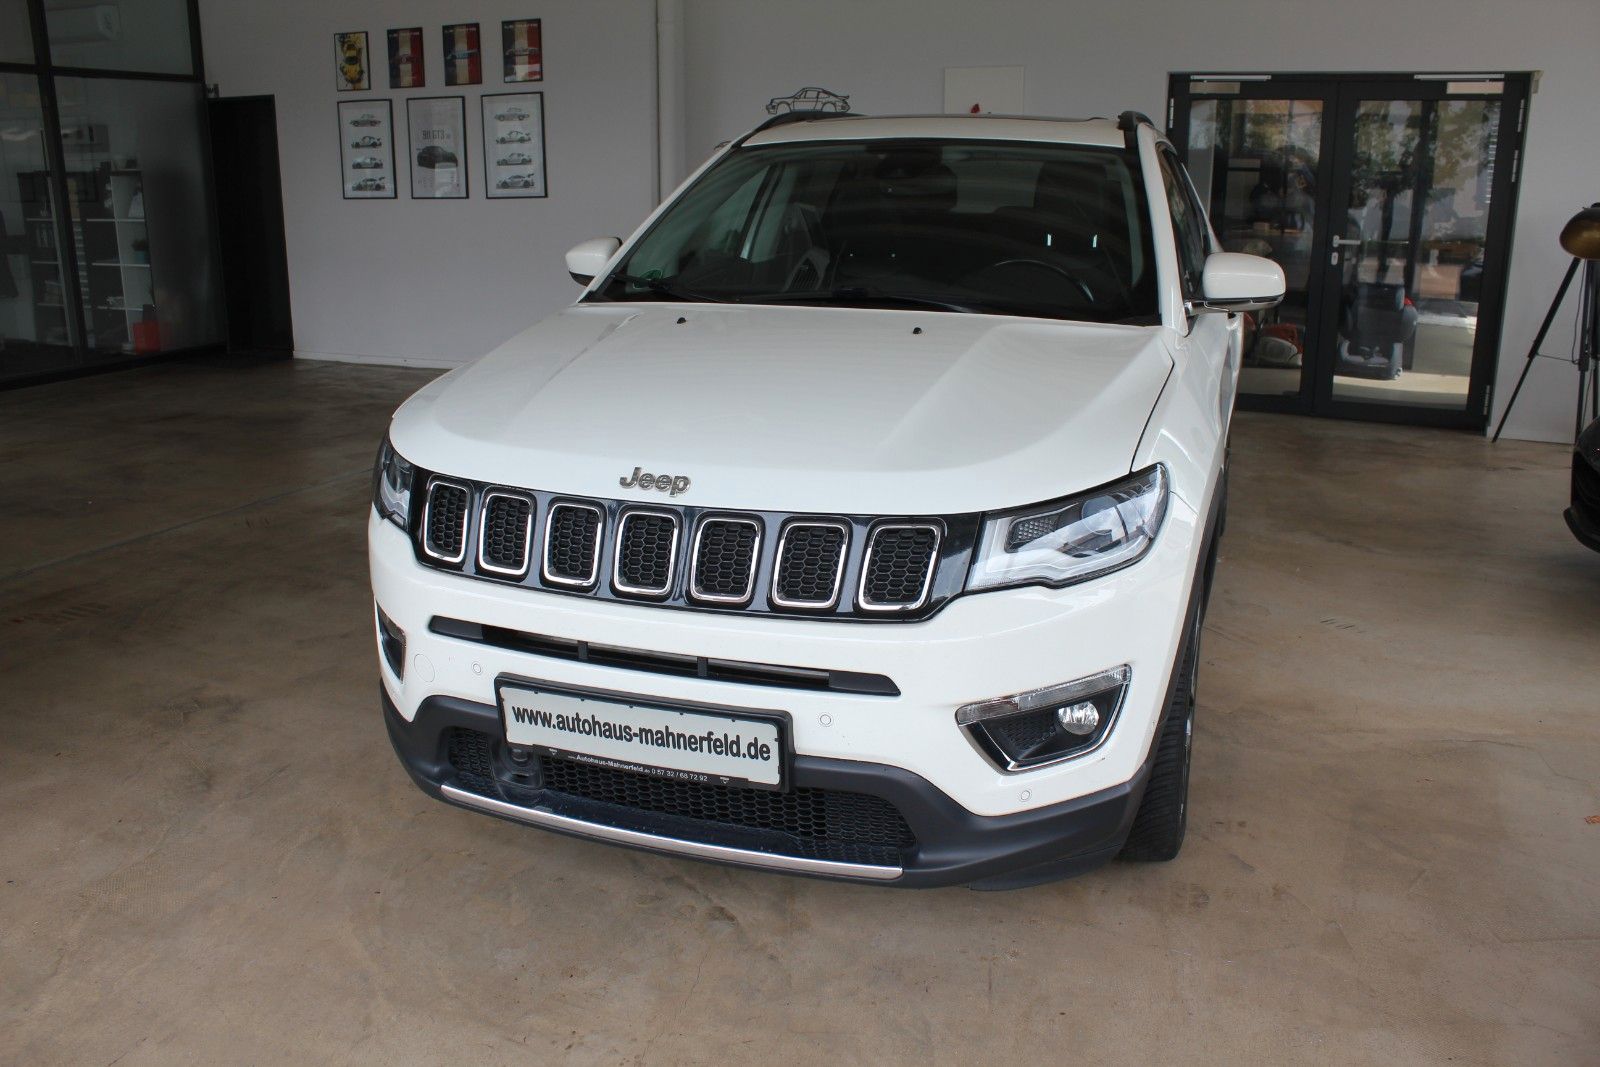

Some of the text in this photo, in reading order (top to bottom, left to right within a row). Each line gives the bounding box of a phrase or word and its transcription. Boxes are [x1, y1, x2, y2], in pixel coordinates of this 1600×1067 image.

[619, 466, 691, 497] Jeep
[512, 705, 771, 761] www.autohaus-mahnerfeld.de
[699, 774, 708, 782] 92
